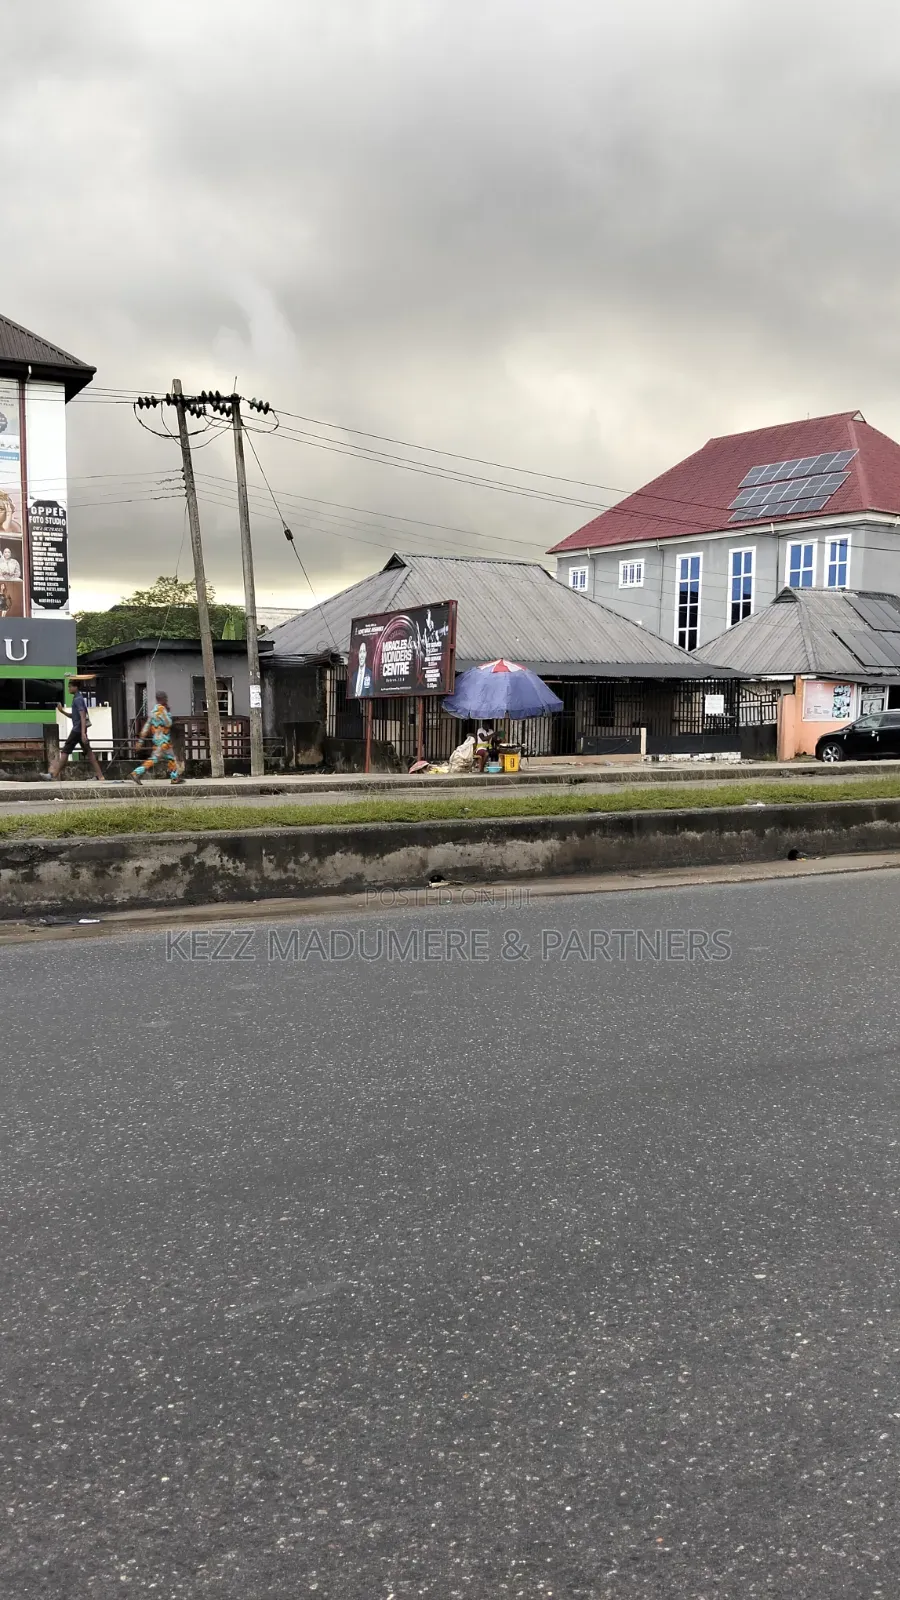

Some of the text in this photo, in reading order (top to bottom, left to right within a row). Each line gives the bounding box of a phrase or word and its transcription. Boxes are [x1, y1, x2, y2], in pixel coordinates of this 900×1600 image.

[31, 506, 64, 517] OPPEE
[29, 515, 66, 526] FOTO STUDIO
[4, 638, 29, 661] U
[382, 639, 408, 652] MIRACLES
[381, 649, 412, 664] WONDERS
[382, 661, 410, 676] CENTRE
